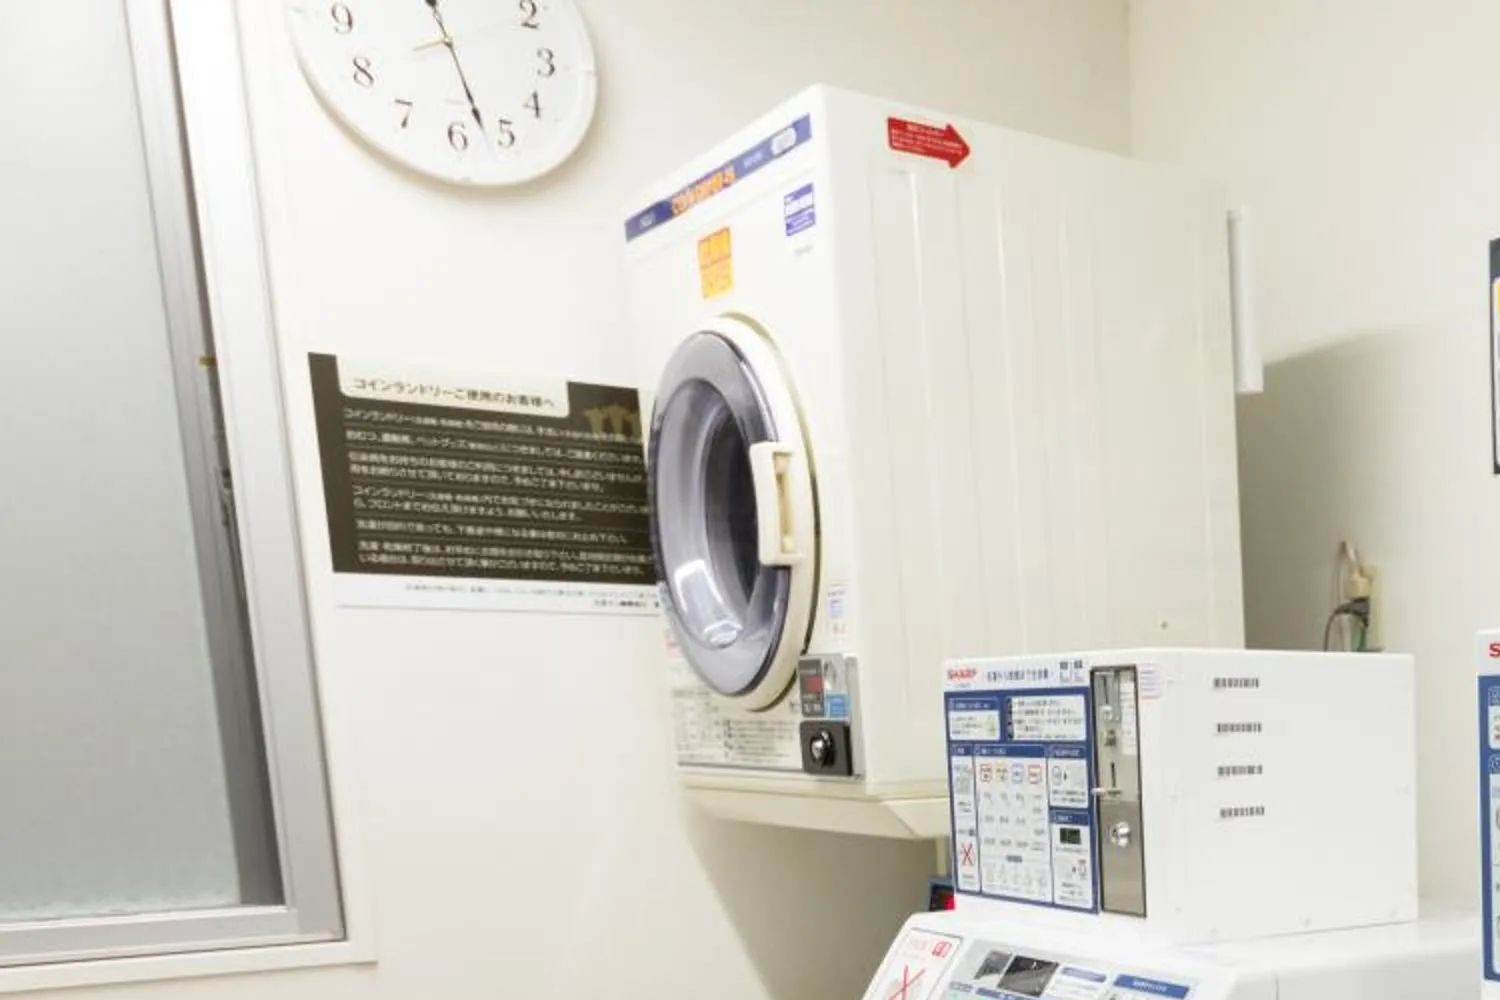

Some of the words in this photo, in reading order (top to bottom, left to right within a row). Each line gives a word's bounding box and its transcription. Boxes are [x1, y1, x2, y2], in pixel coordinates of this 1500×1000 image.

[331, 3, 353, 34] 9
[519, 0, 539, 30] 2
[353, 56, 374, 88] 8
[536, 48, 556, 77] 3
[394, 98, 414, 129] 7
[522, 91, 542, 120] 4
[447, 122, 468, 151] 6
[498, 119, 515, 148] 5
